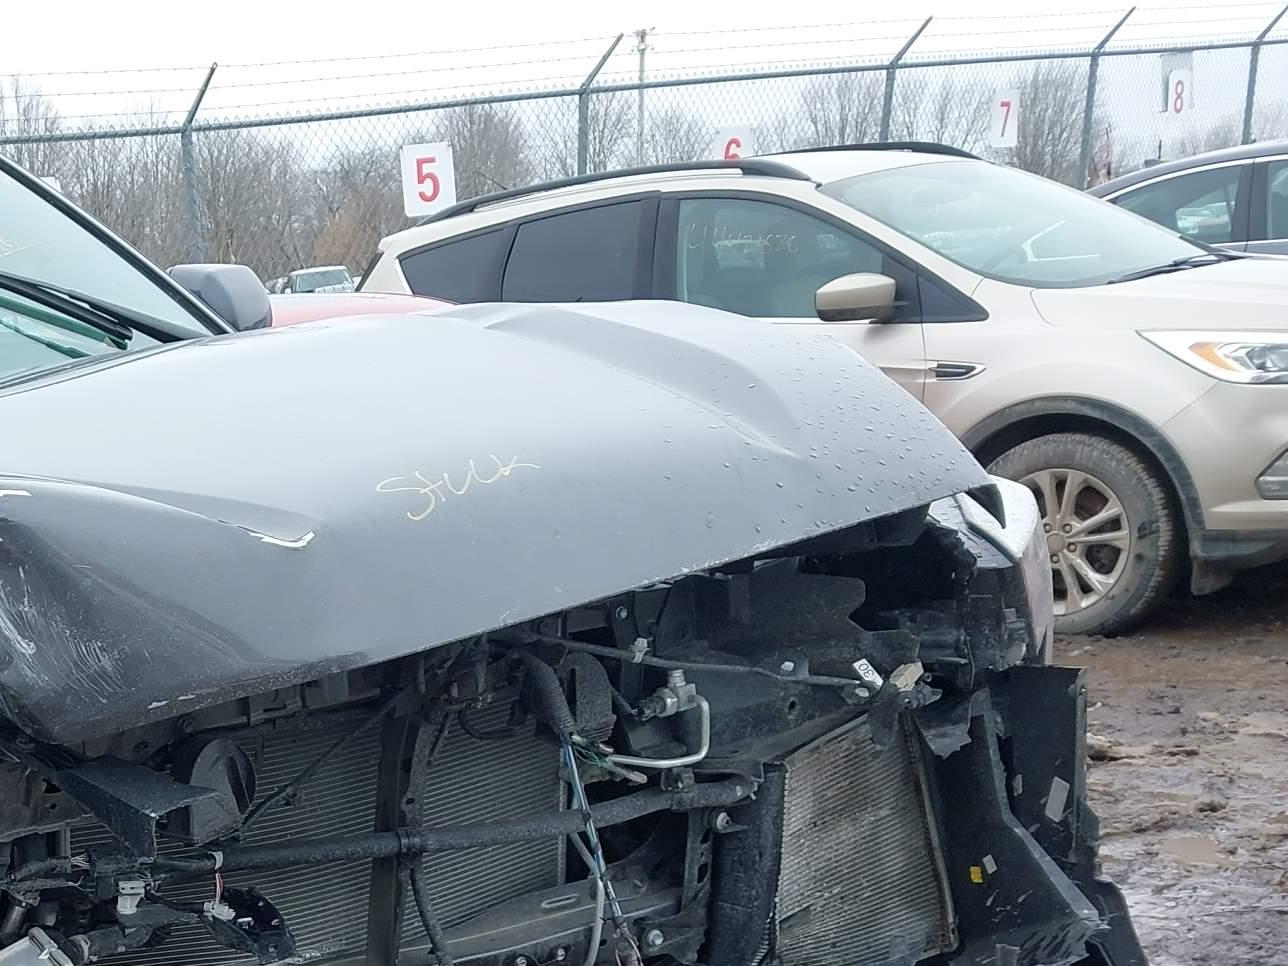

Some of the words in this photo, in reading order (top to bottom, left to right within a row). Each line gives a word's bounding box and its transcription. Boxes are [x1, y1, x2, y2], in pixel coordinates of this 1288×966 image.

[1175, 79, 1184, 113] 8
[1000, 101, 1011, 137] 7
[416, 156, 440, 202] 5
[857, 663, 875, 679] 30
